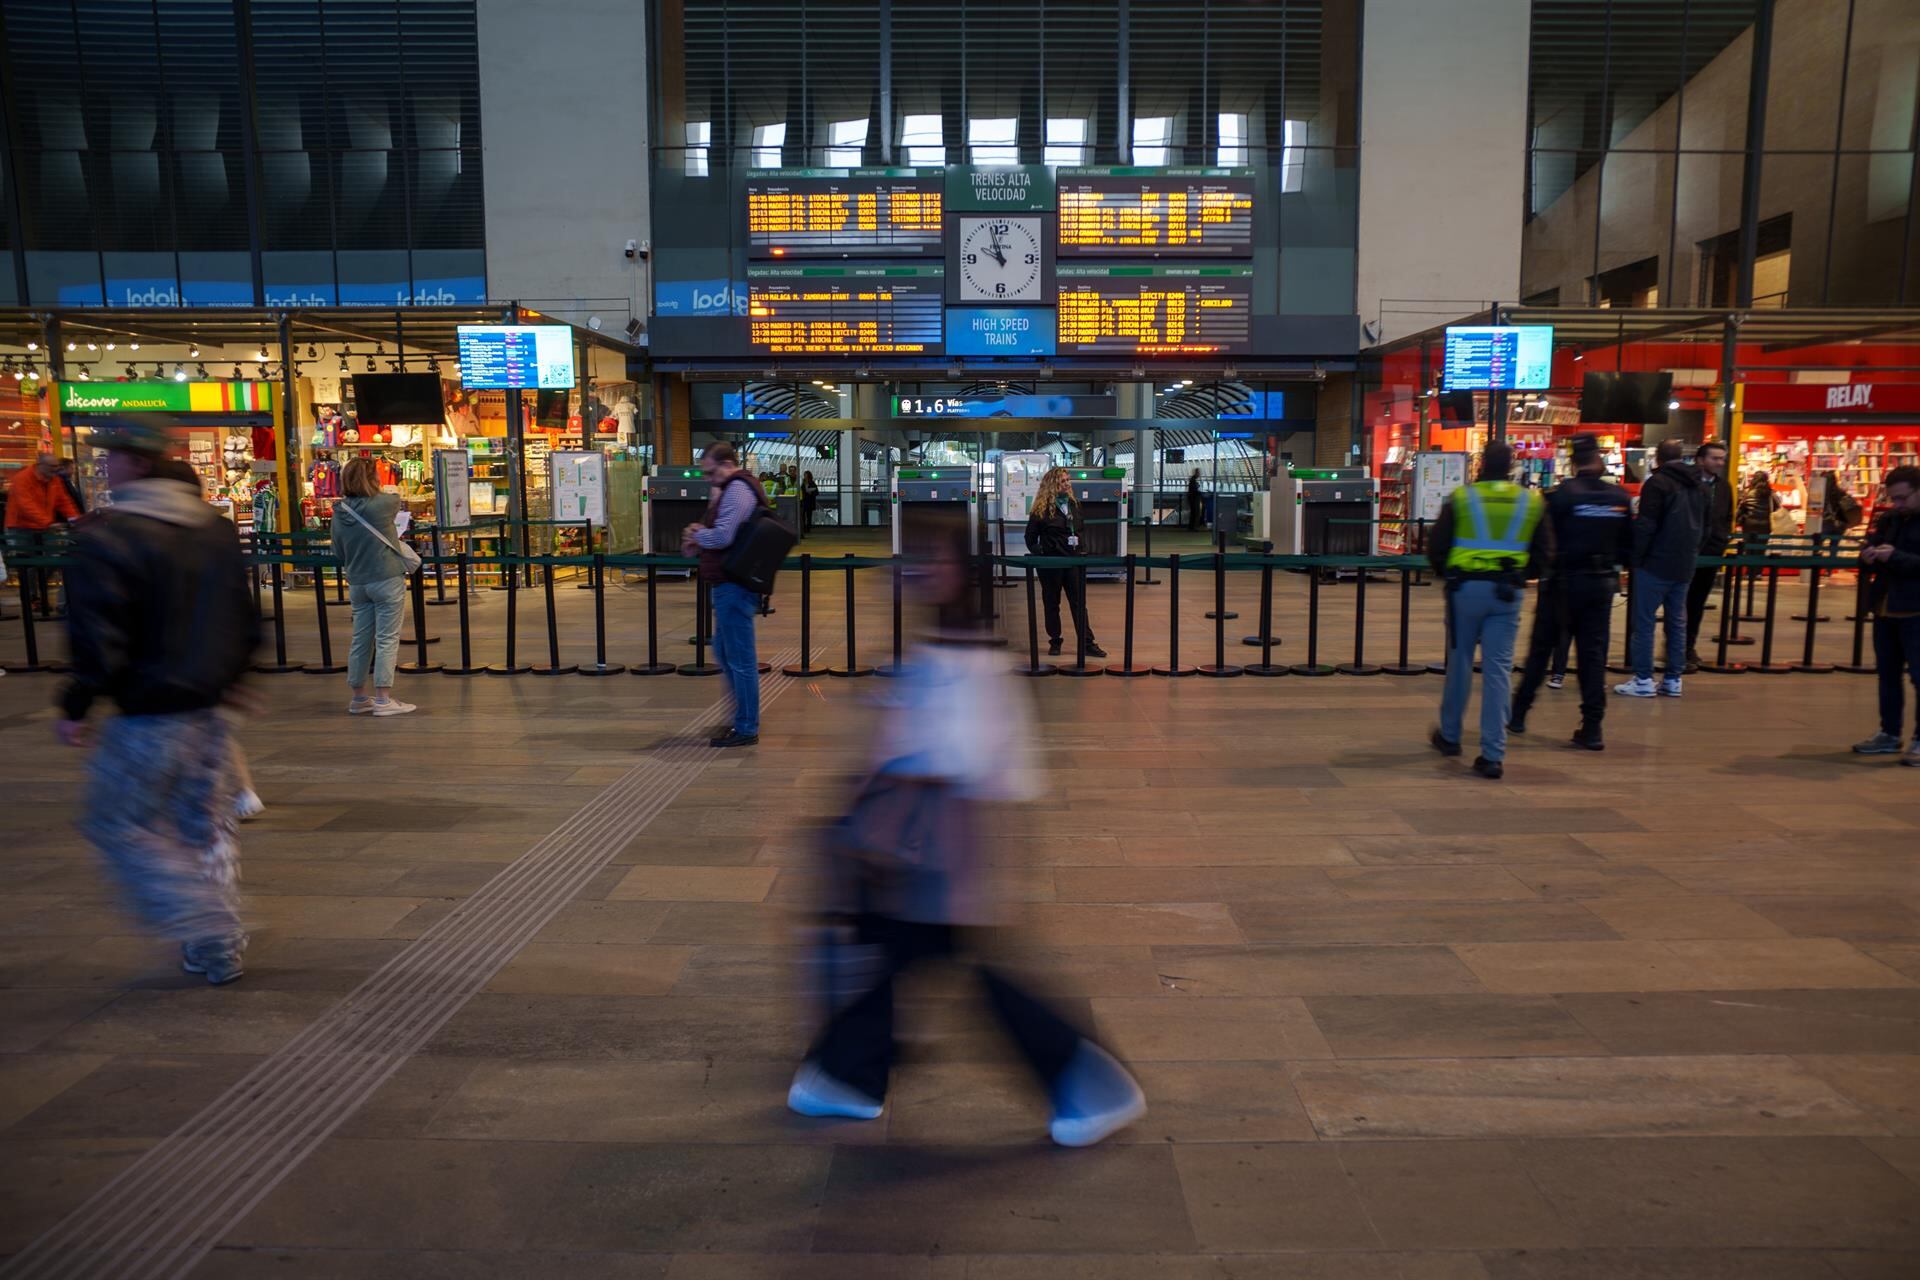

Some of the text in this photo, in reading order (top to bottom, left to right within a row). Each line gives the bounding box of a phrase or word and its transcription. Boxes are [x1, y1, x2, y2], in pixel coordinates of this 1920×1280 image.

[970, 173, 1031, 185] TRENES ALTA
[976, 188, 1026, 200] VELOCIDAD
[993, 225, 1009, 235] 12
[967, 254, 977, 264] 9
[1024, 254, 1034, 264] 3
[996, 283, 1006, 293] 6
[972, 318, 1029, 330] HIGH SPEED
[985, 333, 1017, 345] TRAINS
[66, 386, 167, 408] discover ANDALUCÍA
[1826, 384, 1872, 408] RELAY
[915, 399, 923, 413] 1
[935, 399, 943, 413] 6
[947, 398, 963, 407] Vías
